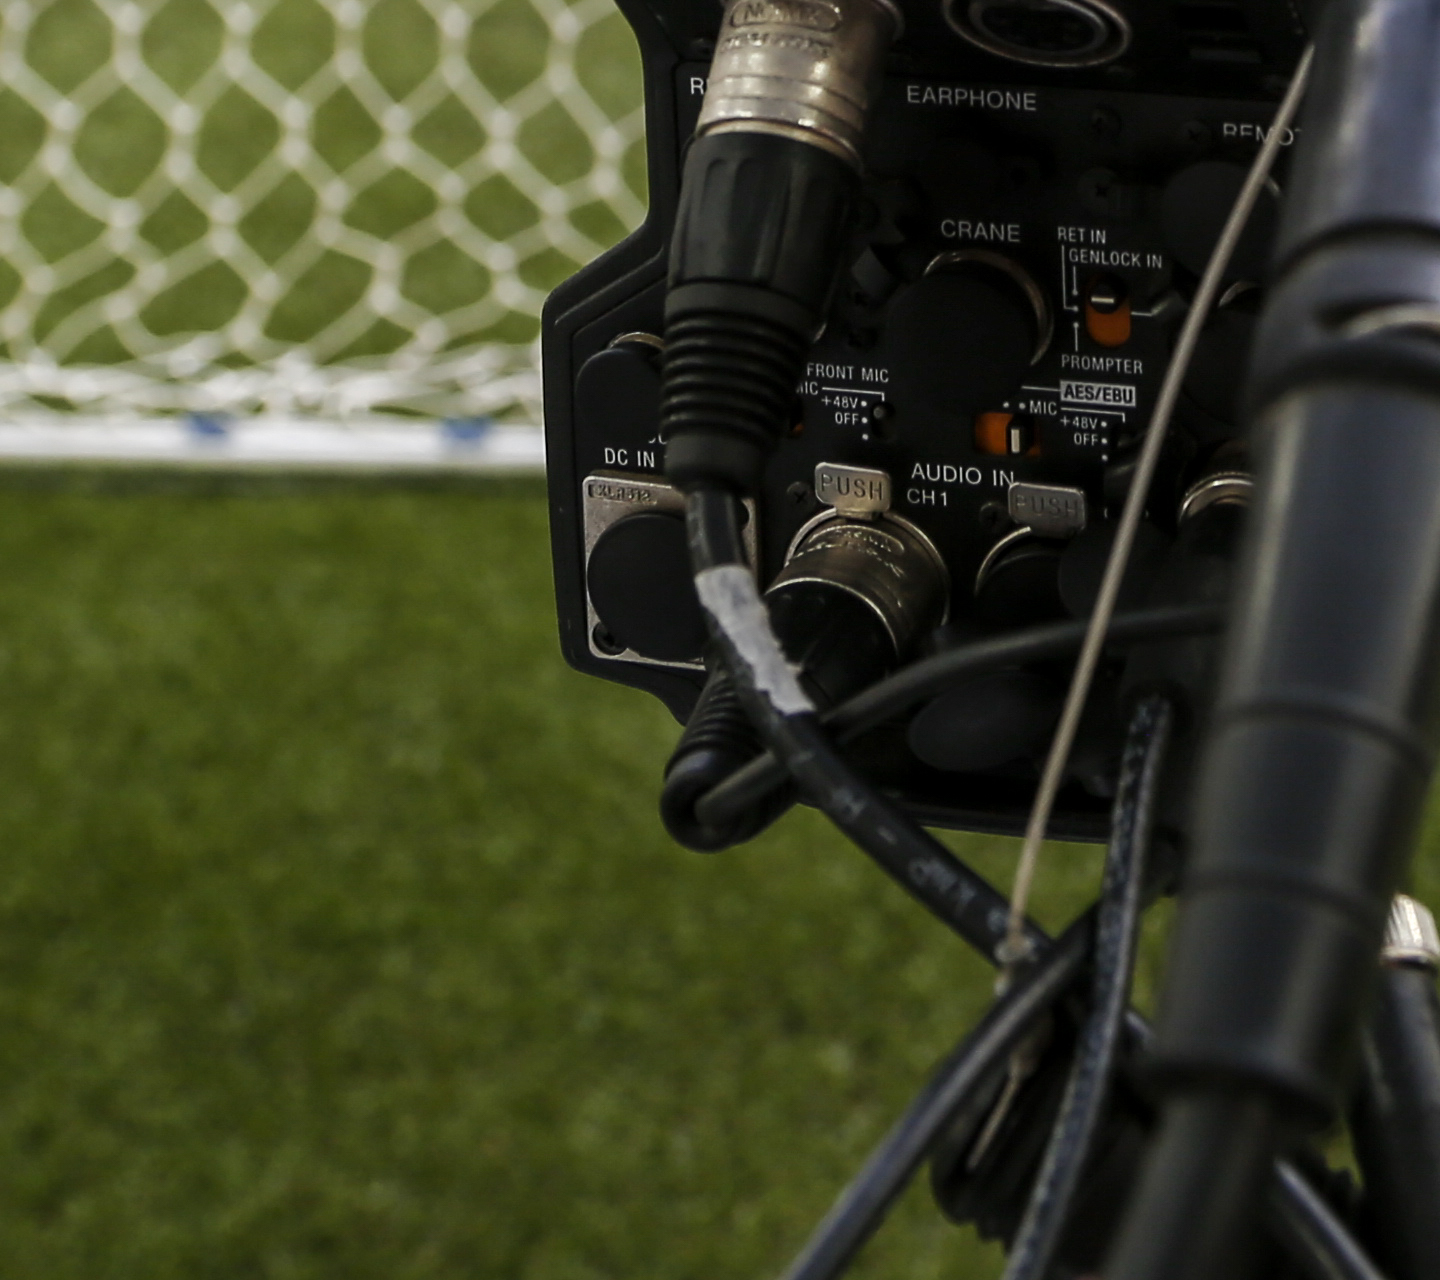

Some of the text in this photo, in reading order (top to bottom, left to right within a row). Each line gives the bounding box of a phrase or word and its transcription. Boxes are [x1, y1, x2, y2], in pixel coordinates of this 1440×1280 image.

[906, 85, 1037, 111] EARPHONE
[940, 219, 1021, 243] CRANE
[1057, 226, 1106, 244] RET IN
[1069, 248, 1163, 269] GENLOCK IN
[806, 362, 889, 383] FRONT MIC
[1061, 354, 1143, 375] PROMPTER
[821, 395, 858, 410] +48V
[1064, 382, 1134, 404] AES/EBU
[835, 411, 859, 426] OFF
[1029, 400, 1057, 416] MIC
[1060, 414, 1098, 430] +48V
[1073, 431, 1098, 446] OFF
[604, 447, 655, 468] DC IN
[911, 463, 1015, 486] AUDIO IN
[821, 473, 883, 501] PUSH
[1015, 495, 1083, 523] PUSH
